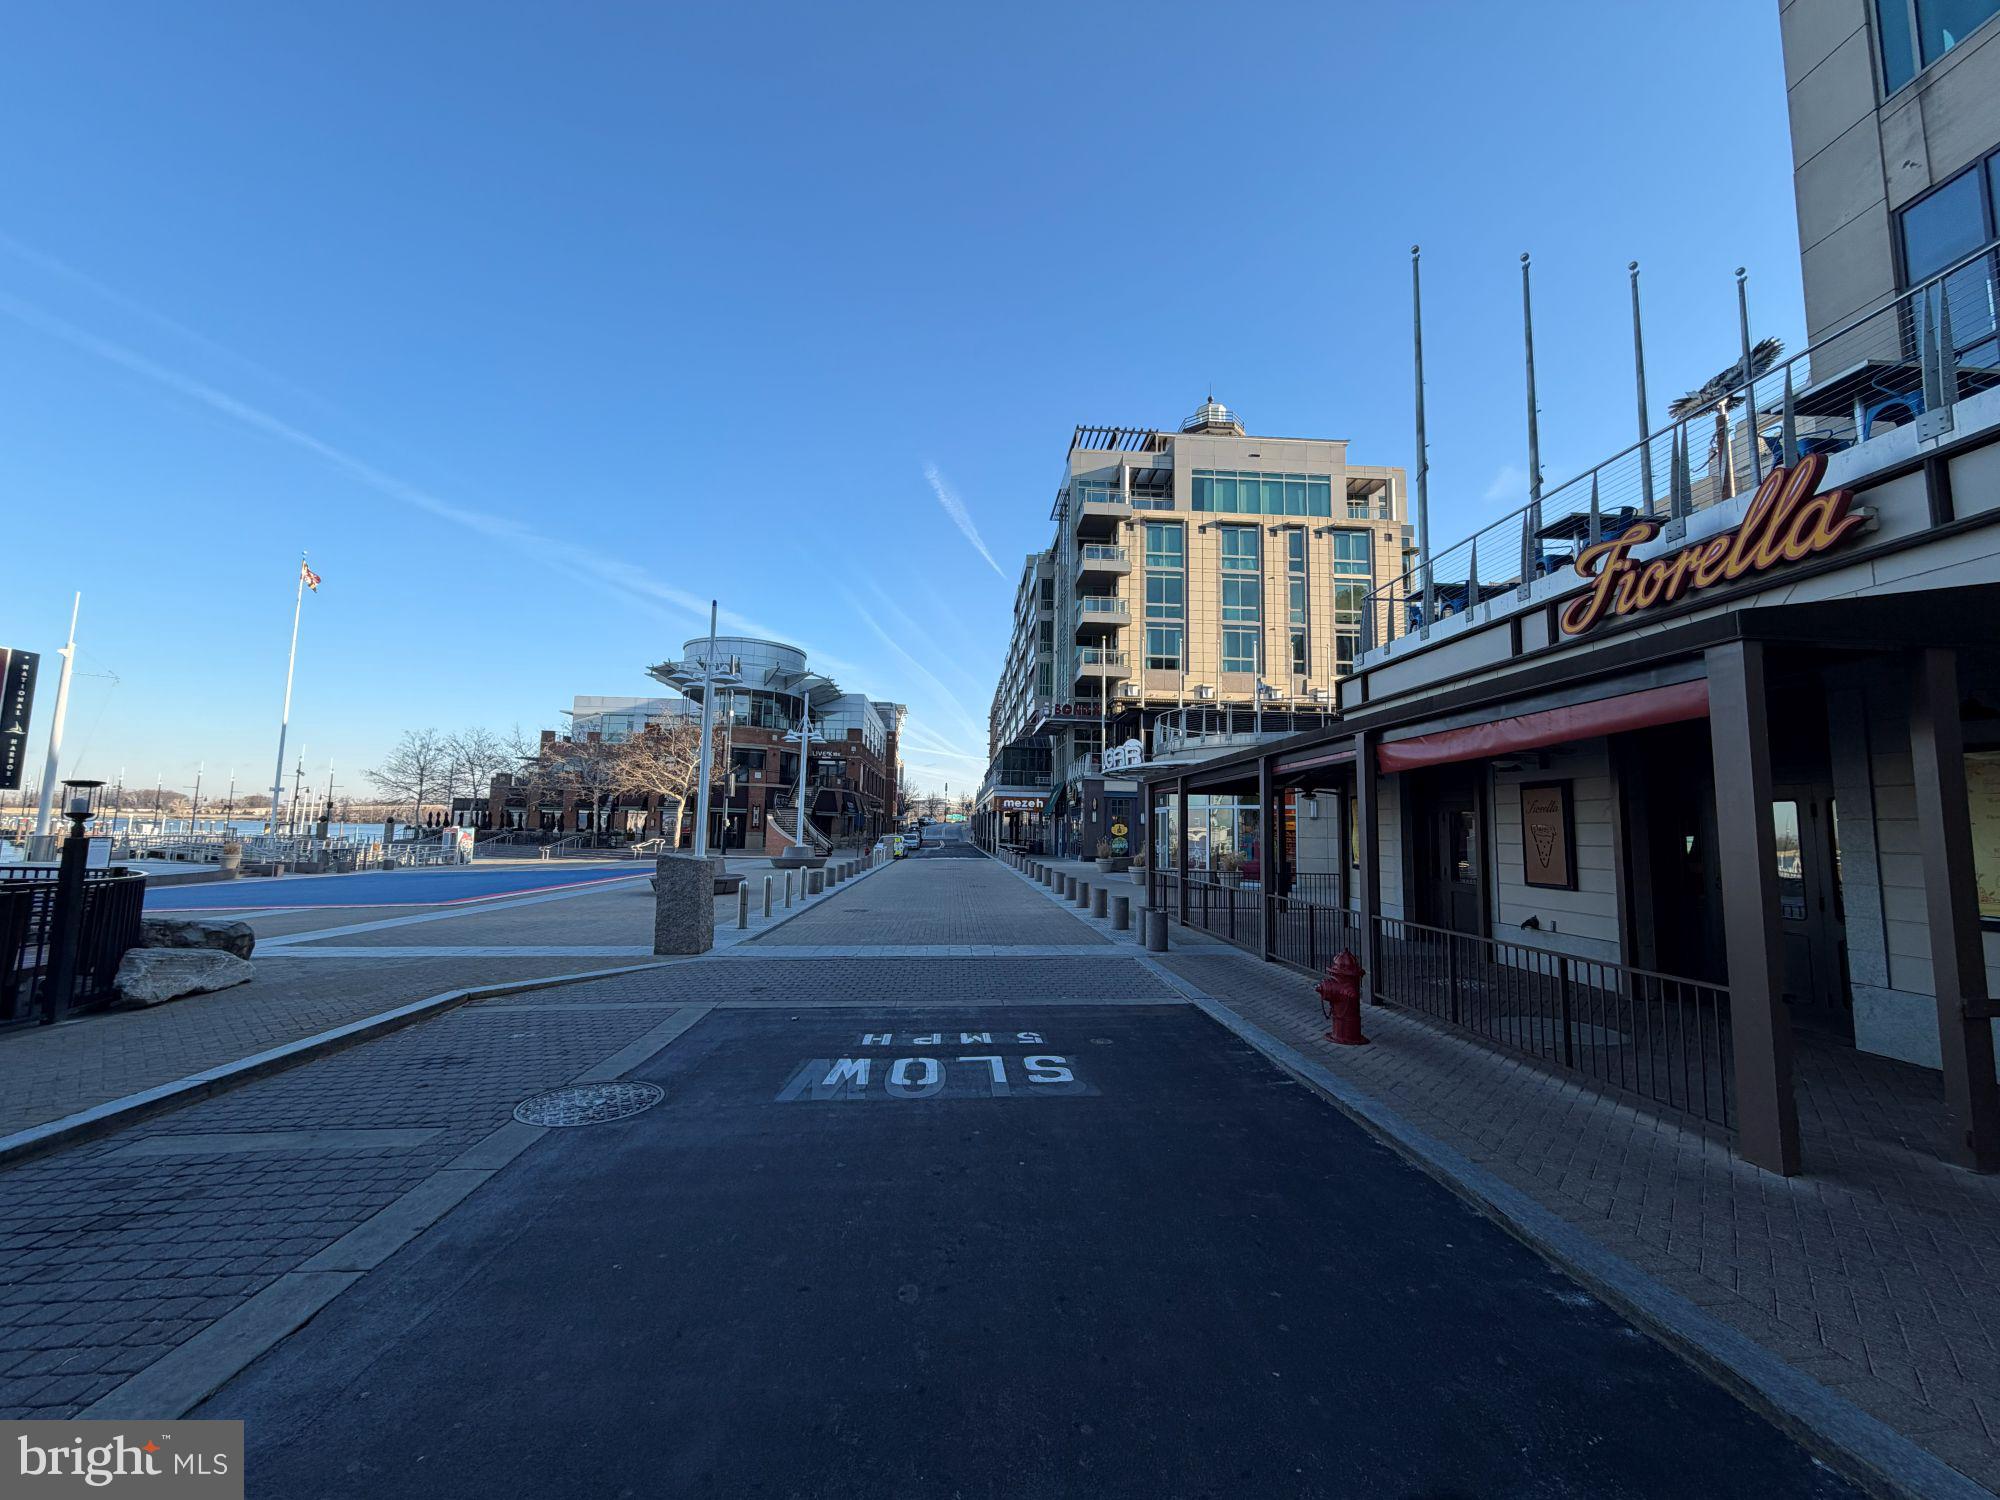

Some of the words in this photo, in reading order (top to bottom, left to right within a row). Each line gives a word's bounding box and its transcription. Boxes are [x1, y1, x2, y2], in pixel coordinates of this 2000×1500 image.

[1561, 453, 1873, 635] Fiorella
[15, 664, 30, 716] NATIONAL
[6, 738, 18, 777] HARBOR
[1003, 798, 1044, 808] mezeh
[1527, 799, 1559, 814] Fiorella
[861, 1032, 992, 1045] MPH
[821, 1055, 1075, 1085] SLOW
